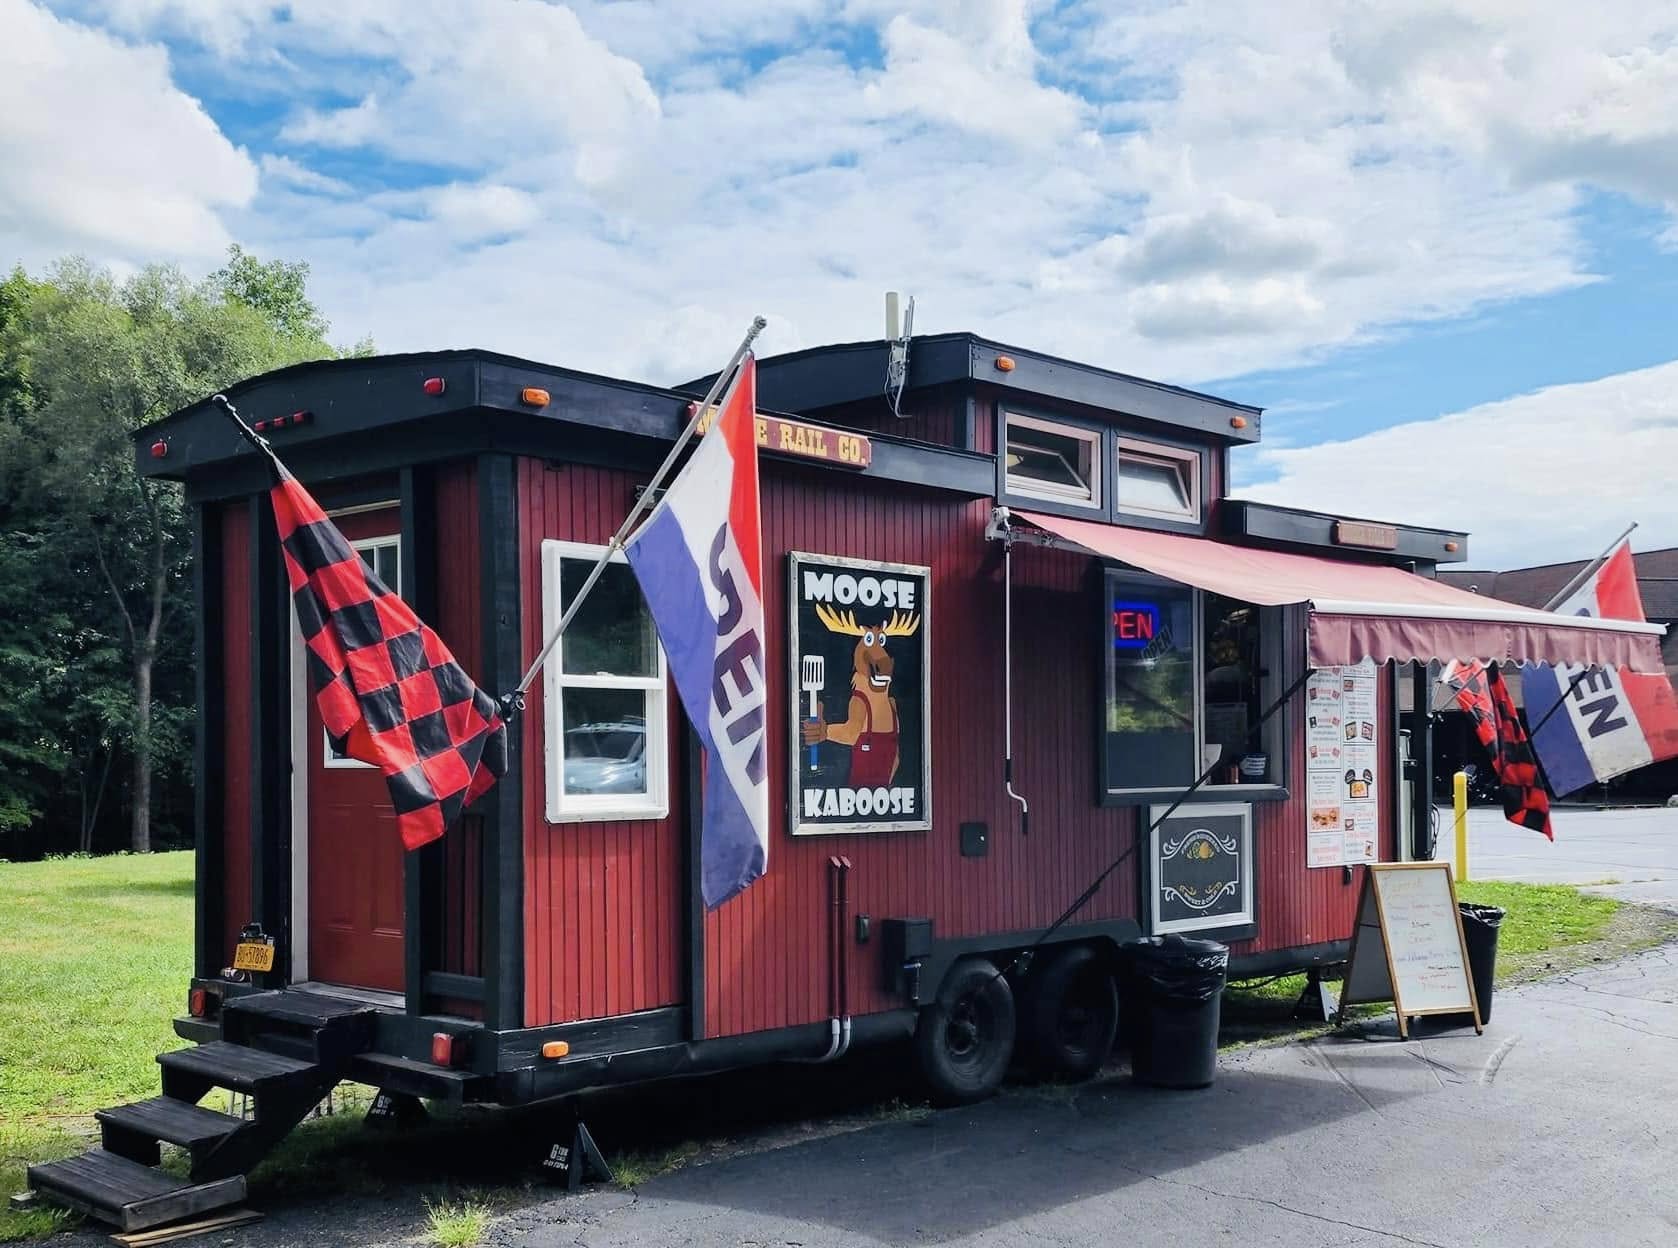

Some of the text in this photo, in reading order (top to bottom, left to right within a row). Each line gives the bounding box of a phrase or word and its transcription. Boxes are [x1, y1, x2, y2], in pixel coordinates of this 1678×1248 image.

[779, 423, 828, 457] RAIL
[838, 435, 867, 464] CO.
[803, 571, 916, 609] MOOSE
[803, 786, 915, 817] KABOOSE
